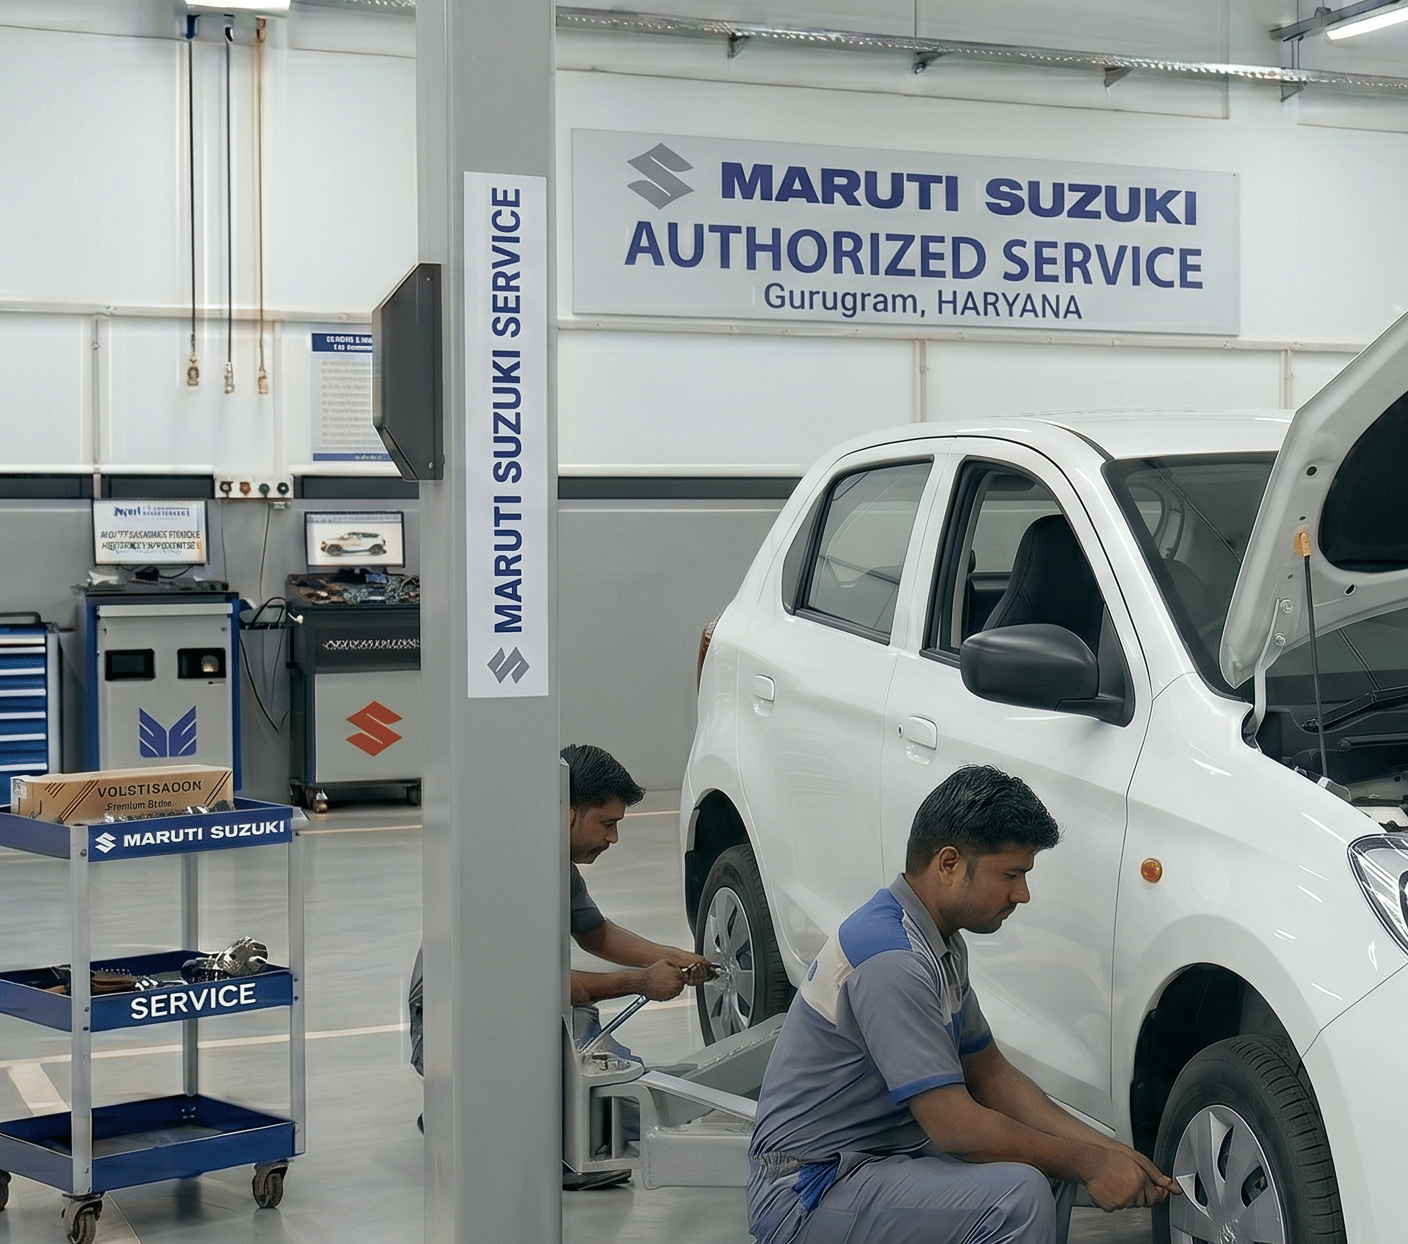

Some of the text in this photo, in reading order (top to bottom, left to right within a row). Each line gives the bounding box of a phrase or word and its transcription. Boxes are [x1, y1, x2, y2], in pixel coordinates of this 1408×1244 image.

[721, 161, 1198, 226] MARUTI SUZUKI
[624, 221, 1204, 290] AUTHORIZED SERVICE
[764, 282, 1083, 319] Gurugram, HARYANA
[492, 187, 522, 633] MARUTI SUZUKI SERVICE
[123, 820, 285, 848] MARUTI SUZUKI
[130, 982, 257, 1020] SERVICE
